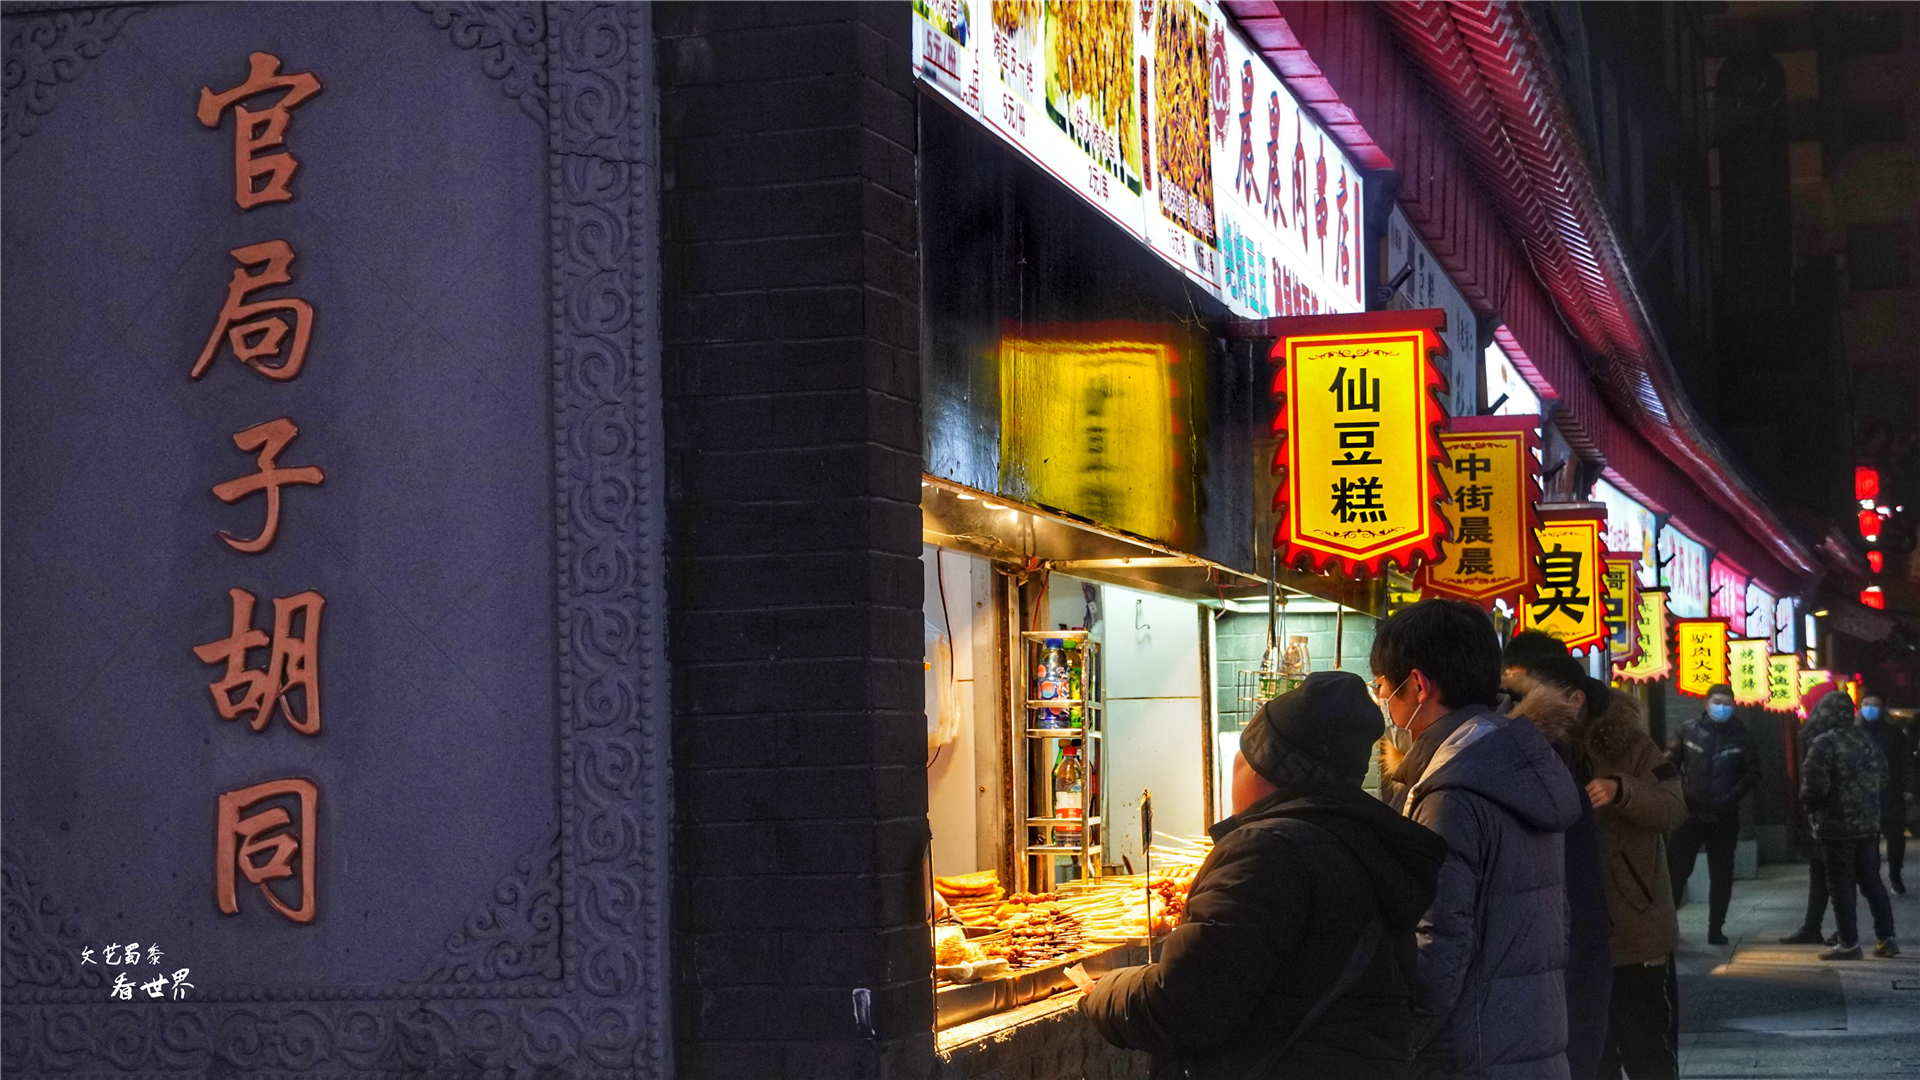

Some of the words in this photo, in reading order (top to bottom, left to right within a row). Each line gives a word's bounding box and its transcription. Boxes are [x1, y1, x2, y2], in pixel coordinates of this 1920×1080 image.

[927, 30, 957, 79] 5元/份
[993, 29, 1033, 93] 烤豆皮一绝
[1003, 93, 1025, 138] 5元/份
[1076, 104, 1114, 161] 特大烤肉串
[1236, 59, 1350, 288] 晨晨肉串店
[1329, 366, 1387, 523] 仙豆糕
[190, 51, 325, 924] 官局子胡同
[1454, 453, 1494, 576] 中街晨晨
[1690, 632, 1714, 684] 驴肉火烧
